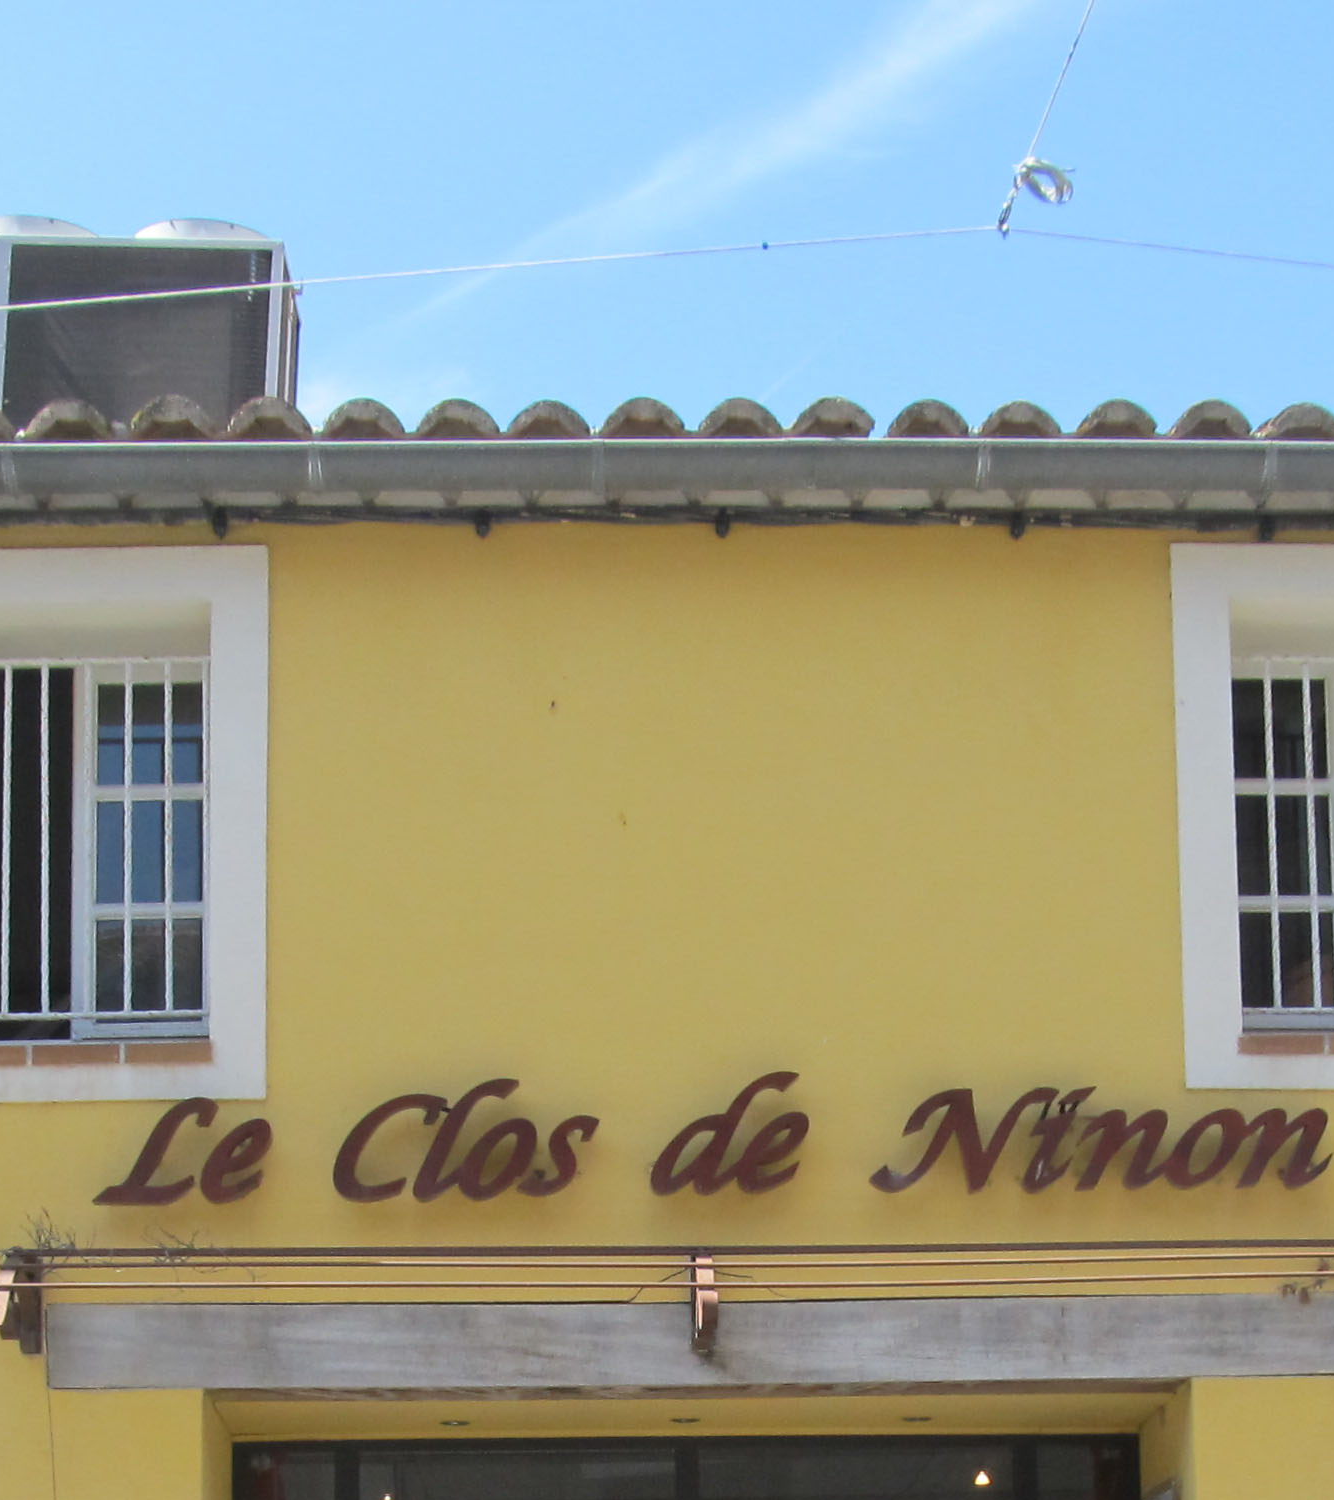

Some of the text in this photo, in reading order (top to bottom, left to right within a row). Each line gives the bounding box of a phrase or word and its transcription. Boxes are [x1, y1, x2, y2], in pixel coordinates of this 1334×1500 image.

[92, 1070, 1334, 1206] Le Clos de Ninon
